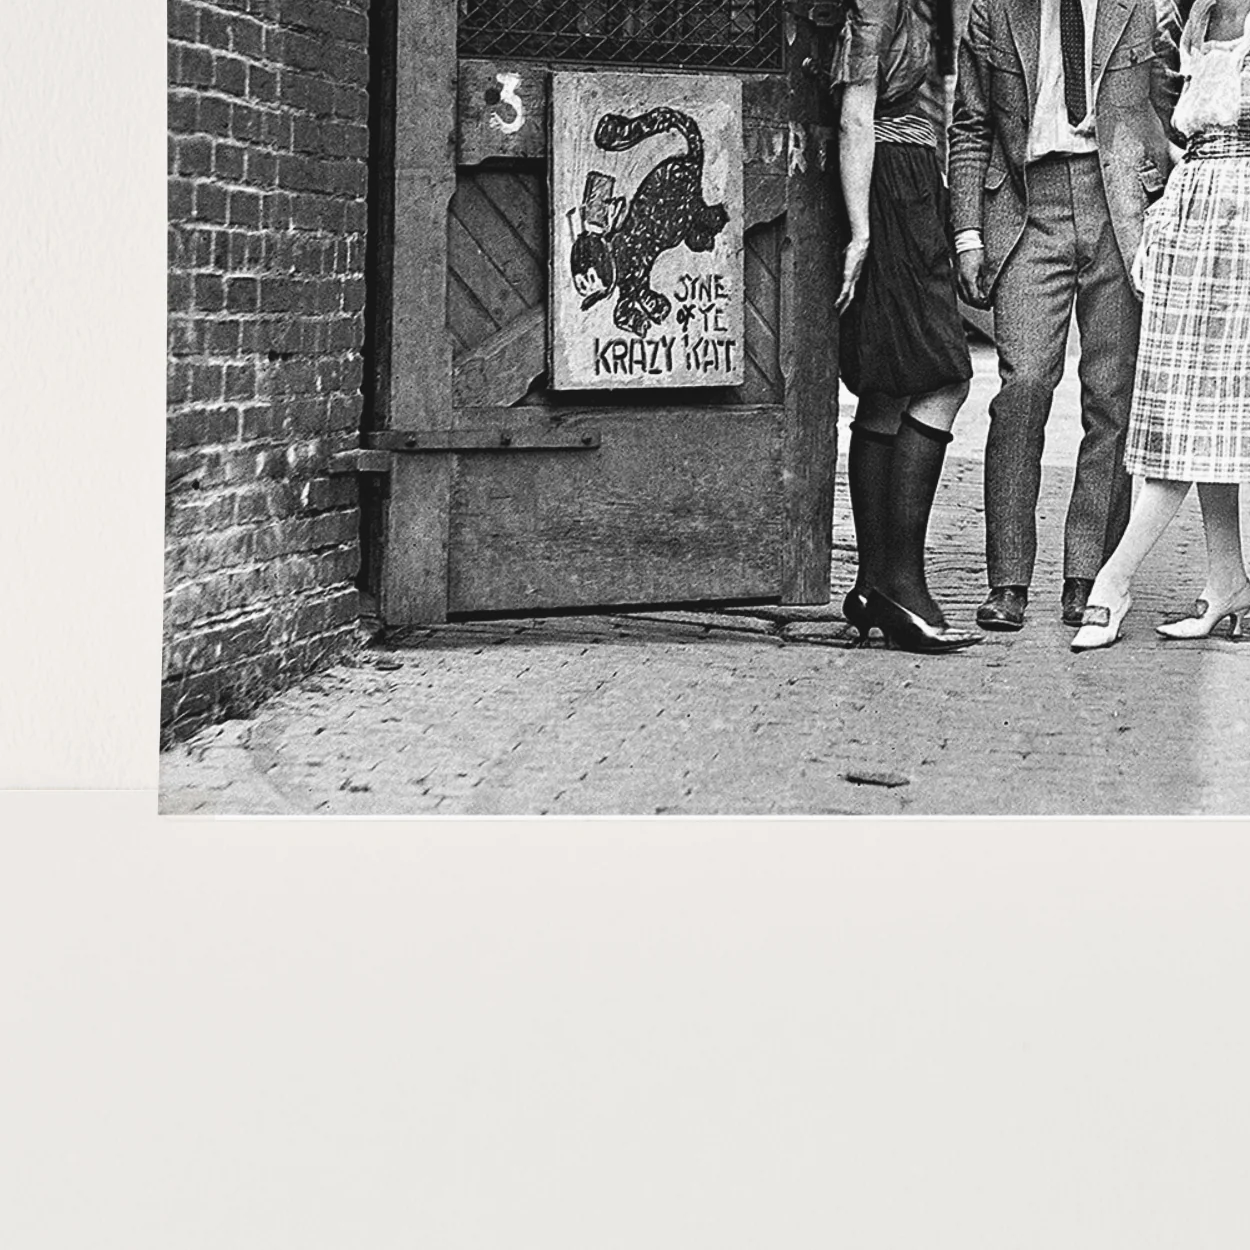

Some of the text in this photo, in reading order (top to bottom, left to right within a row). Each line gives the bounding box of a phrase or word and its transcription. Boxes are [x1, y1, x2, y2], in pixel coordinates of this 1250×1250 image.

[490, 73, 524, 133] 3
[698, 303, 728, 332] YE
[595, 336, 676, 375] KRAZY
